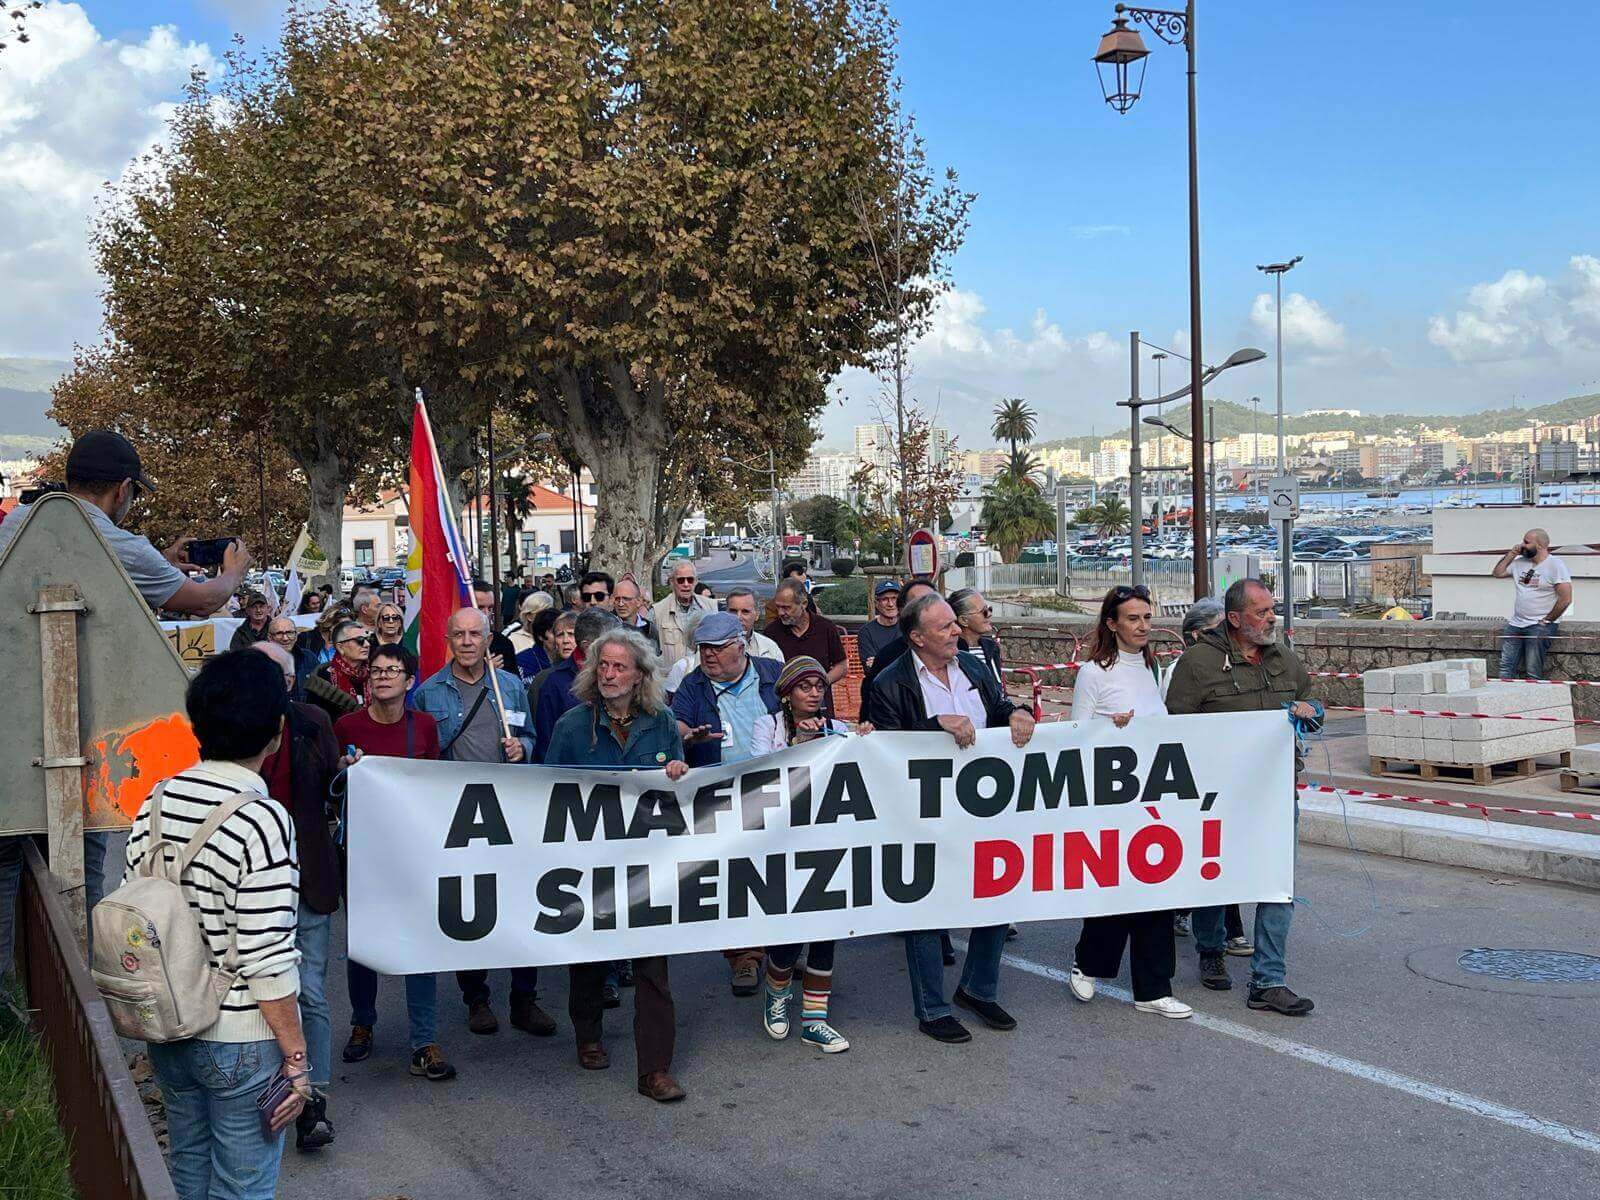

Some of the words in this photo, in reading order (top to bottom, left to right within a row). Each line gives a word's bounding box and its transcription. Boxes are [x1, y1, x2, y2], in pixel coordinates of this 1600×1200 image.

[444, 783, 513, 848] A
[542, 762, 876, 843] MAFFIA
[908, 743, 1218, 819] TOMBA,
[438, 873, 497, 941] U
[534, 843, 936, 934] SILENZIU
